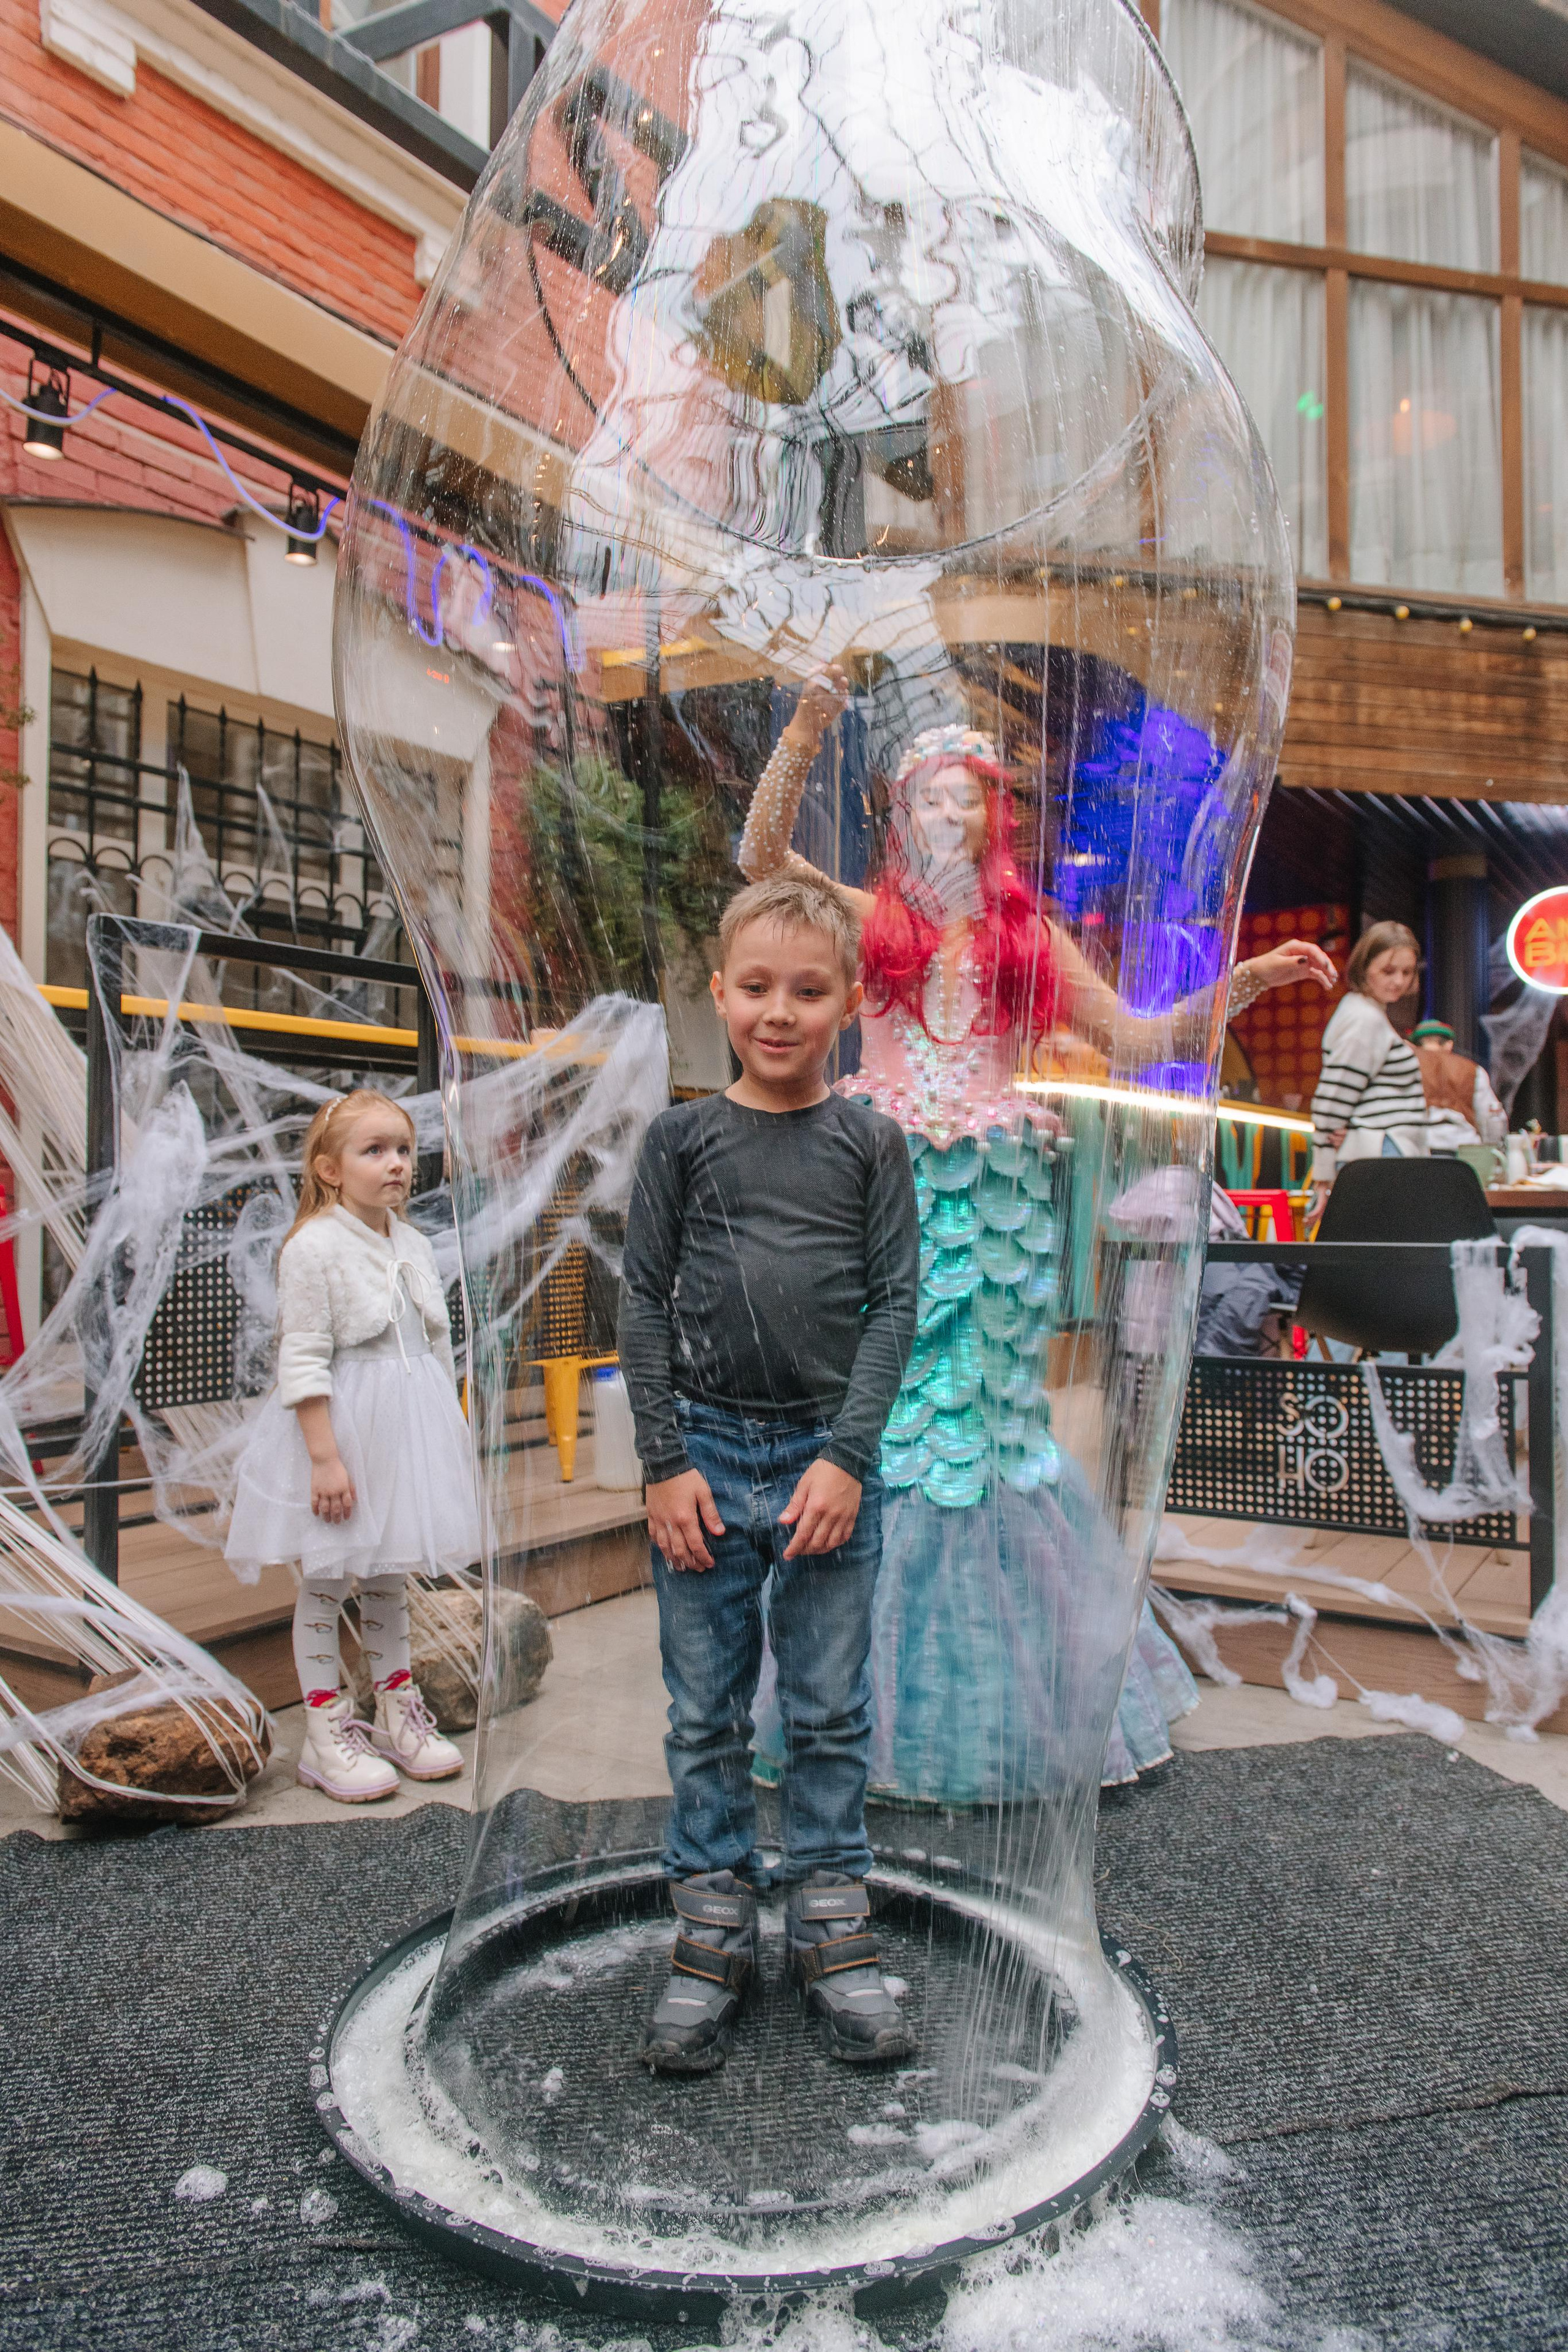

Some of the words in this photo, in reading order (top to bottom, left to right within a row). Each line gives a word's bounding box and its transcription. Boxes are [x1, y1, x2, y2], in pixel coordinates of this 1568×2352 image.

[1275, 1392, 1349, 1439] SO
[1276, 1444, 1349, 1493] HO
[702, 1904, 739, 1915] GEOX
[809, 1898, 846, 1907] GEOX
